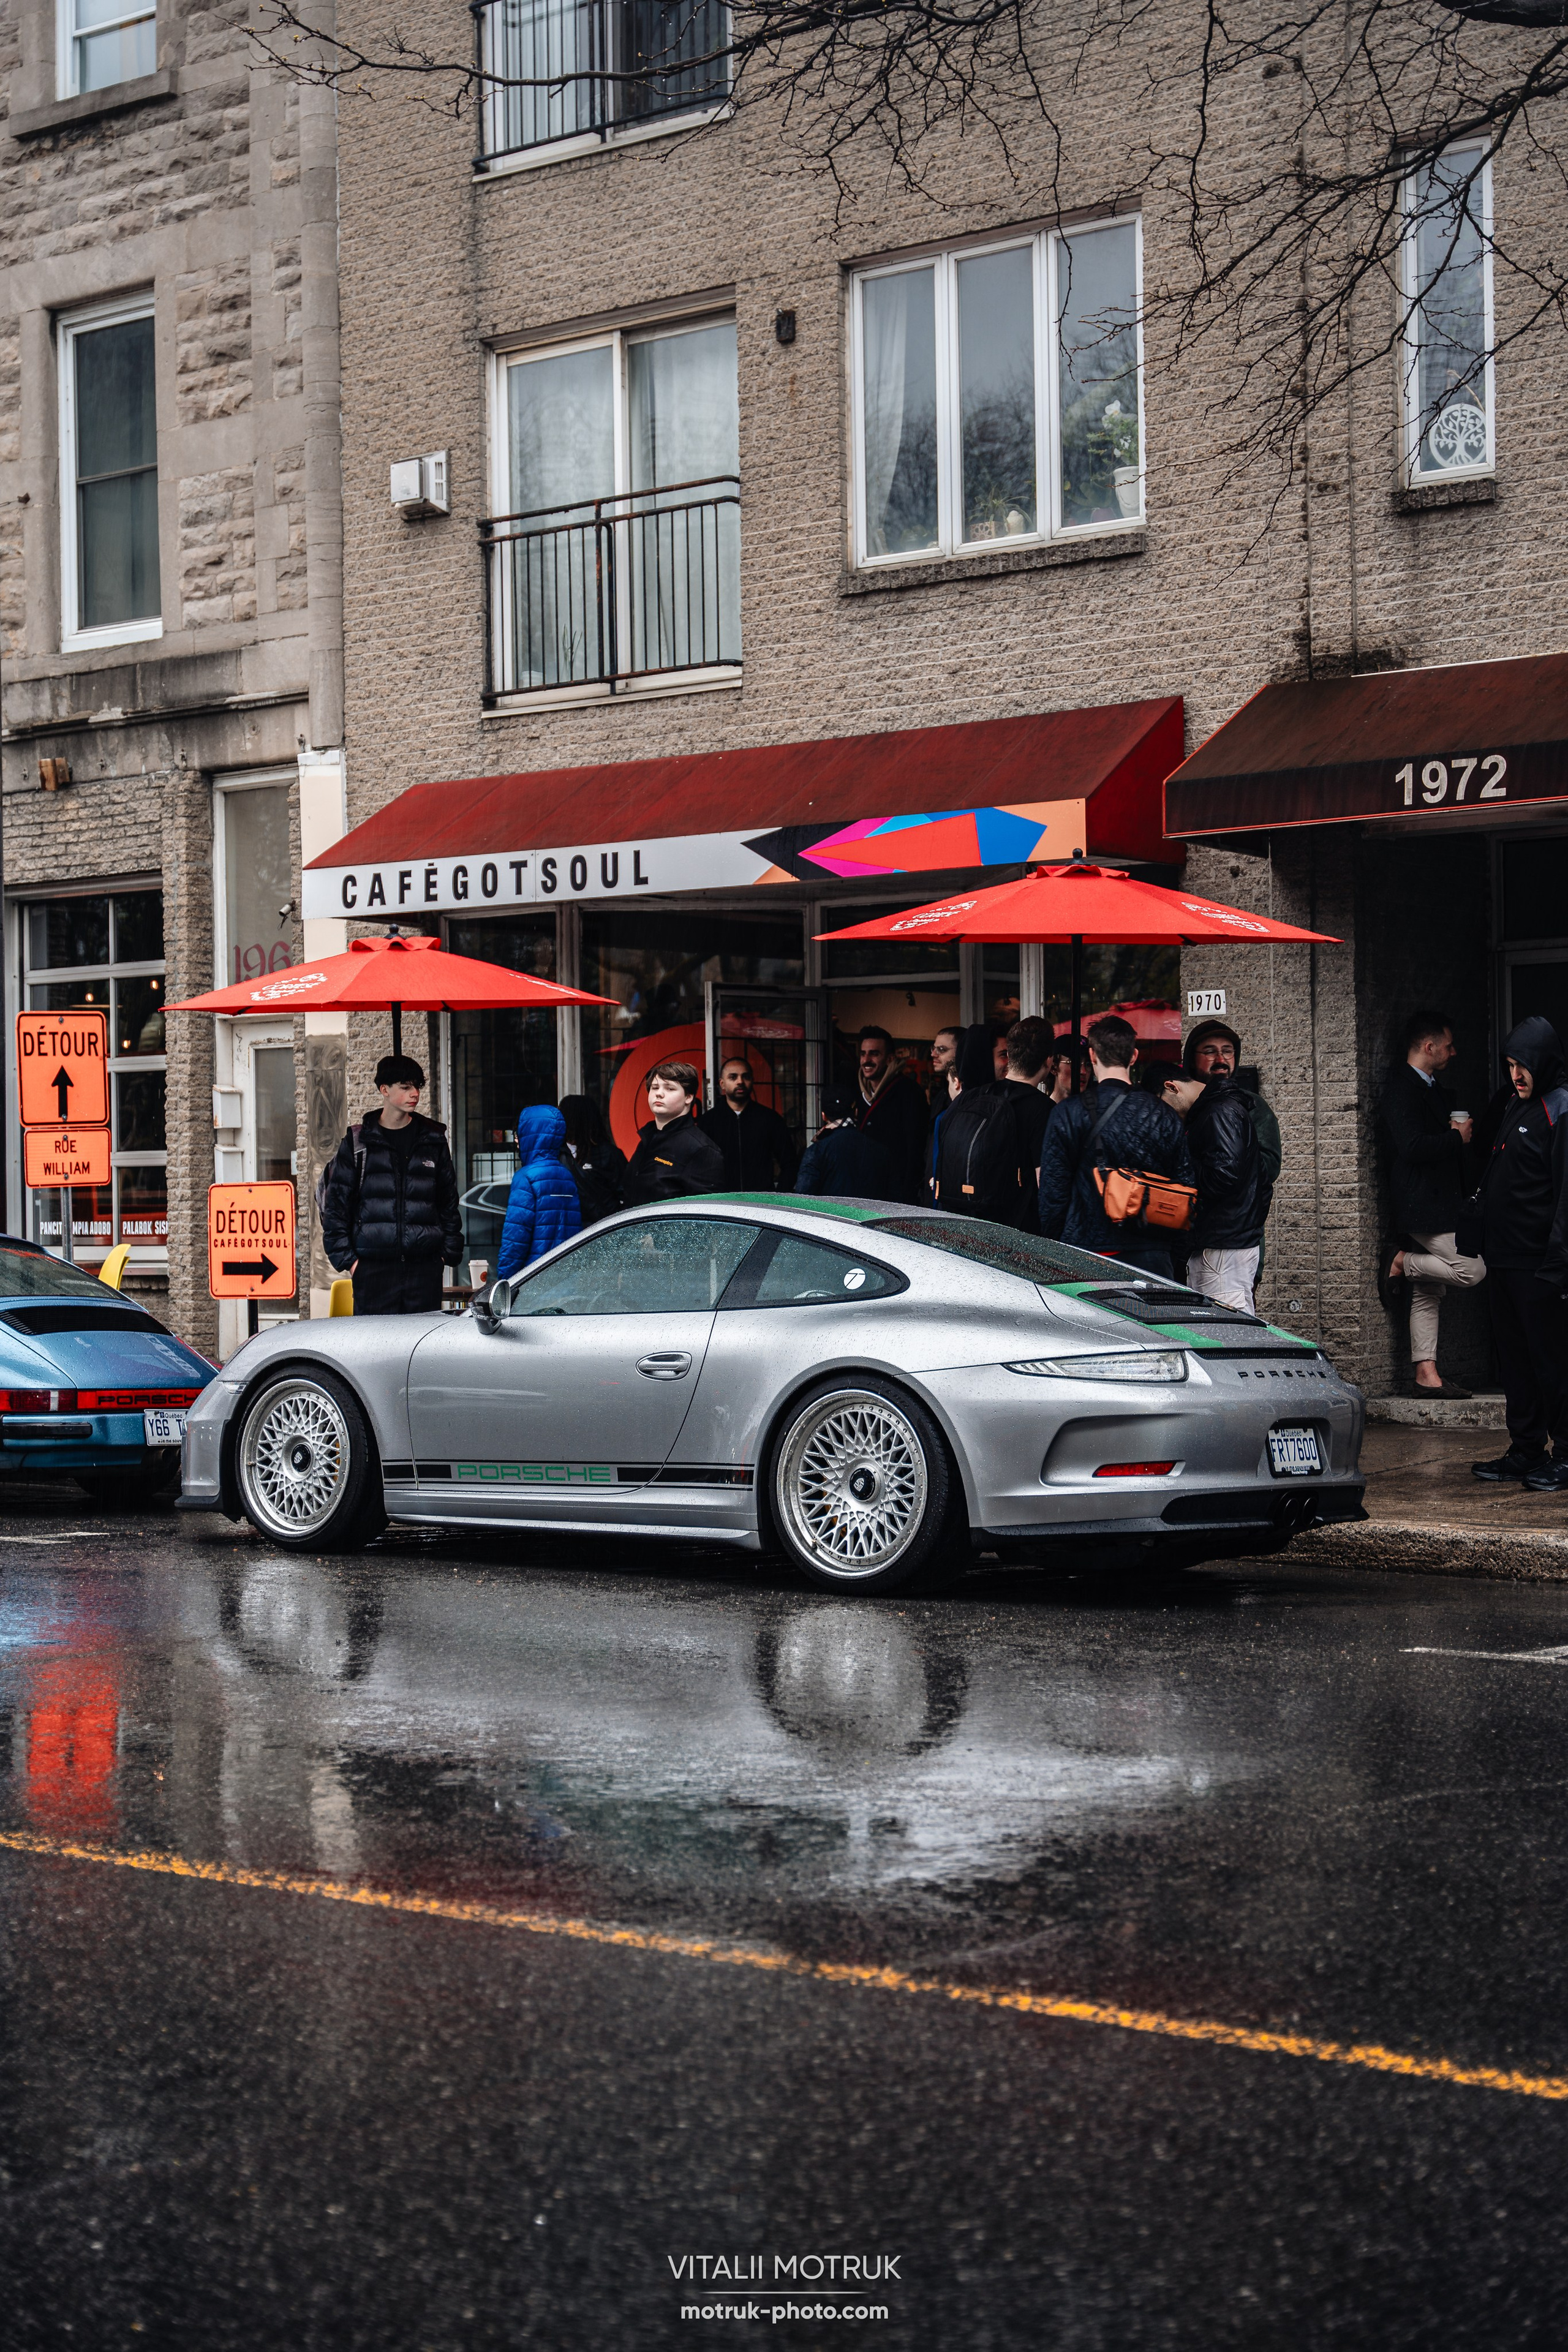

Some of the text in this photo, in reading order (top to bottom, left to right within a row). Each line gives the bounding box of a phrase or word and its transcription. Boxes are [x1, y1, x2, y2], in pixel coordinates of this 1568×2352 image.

[1395, 755, 1507, 805] 1972
[1190, 993, 1221, 1012] 1970
[23, 1025, 99, 1057] DÉTOUR
[55, 1140, 77, 1153] RUE
[43, 1161, 90, 1175] WILLIAM
[216, 1202, 285, 1234] DÉTOUR
[40, 1220, 168, 1235] PANCIT MPIA ADOBO PALABOK SISI
[1237, 1370, 1327, 1379] PORSCHE
[97, 1395, 197, 1405] PORSCH
[148, 1419, 184, 1436] Y66 T
[1270, 1437, 1317, 1463] FRT7600
[457, 1464, 611, 1482] PORSCHE
